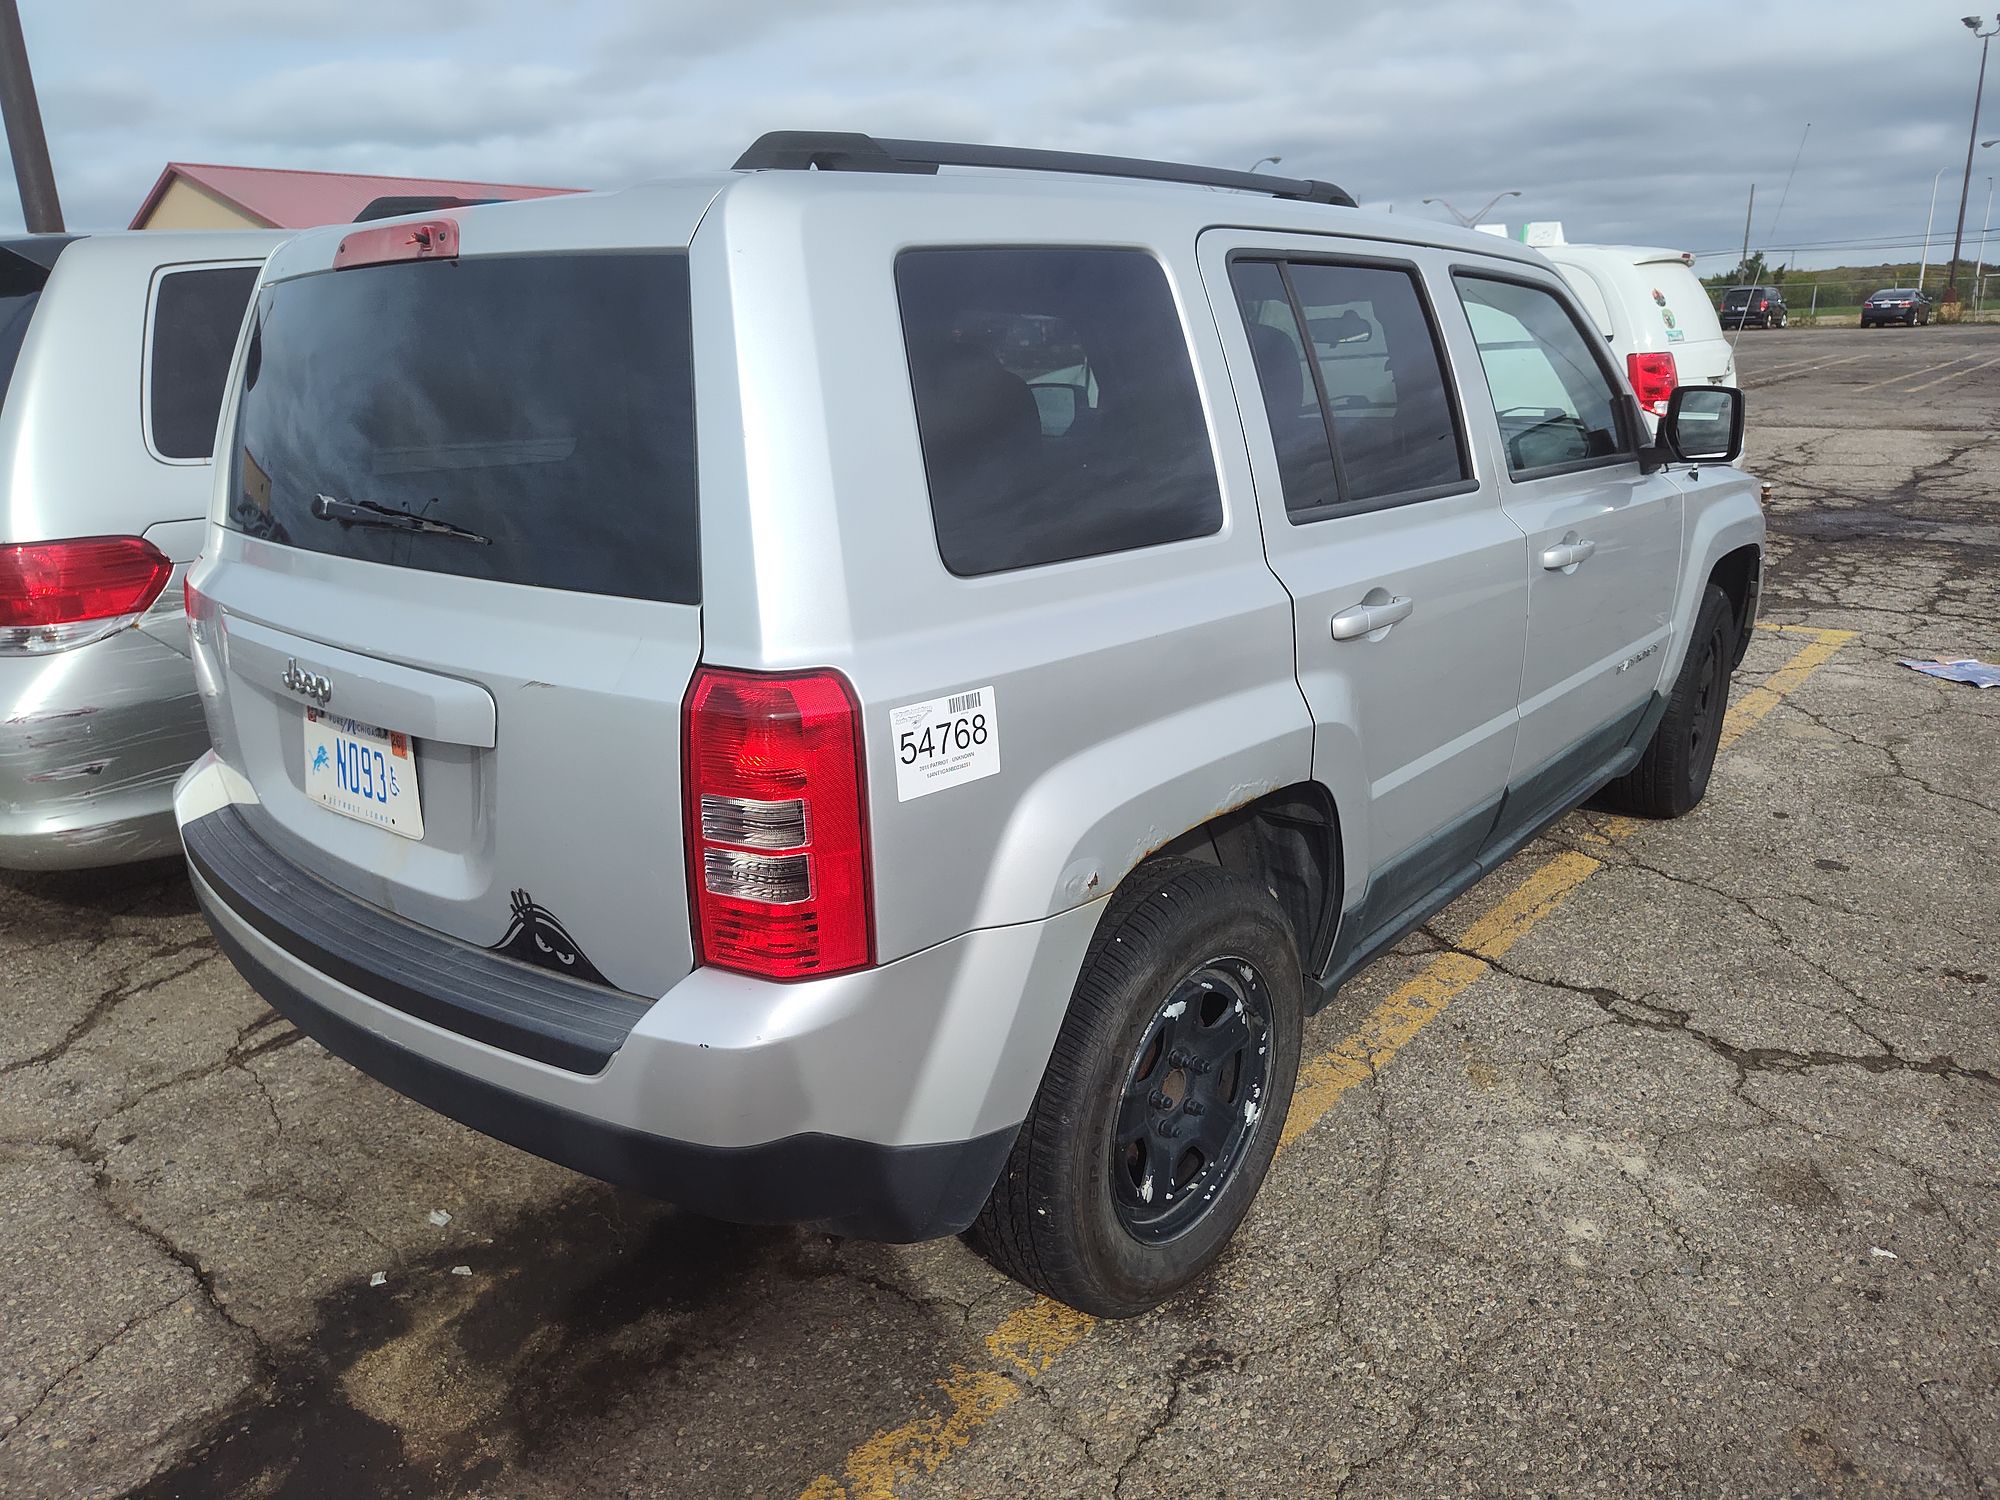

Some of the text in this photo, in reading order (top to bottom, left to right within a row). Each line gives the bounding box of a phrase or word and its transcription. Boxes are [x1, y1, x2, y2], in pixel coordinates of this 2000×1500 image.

[900, 714, 987, 765] 54768
[929, 758, 949, 769] PATRIOT
[951, 751, 975, 763] UNKNOWN
[365, 809, 388, 824] LIONS
